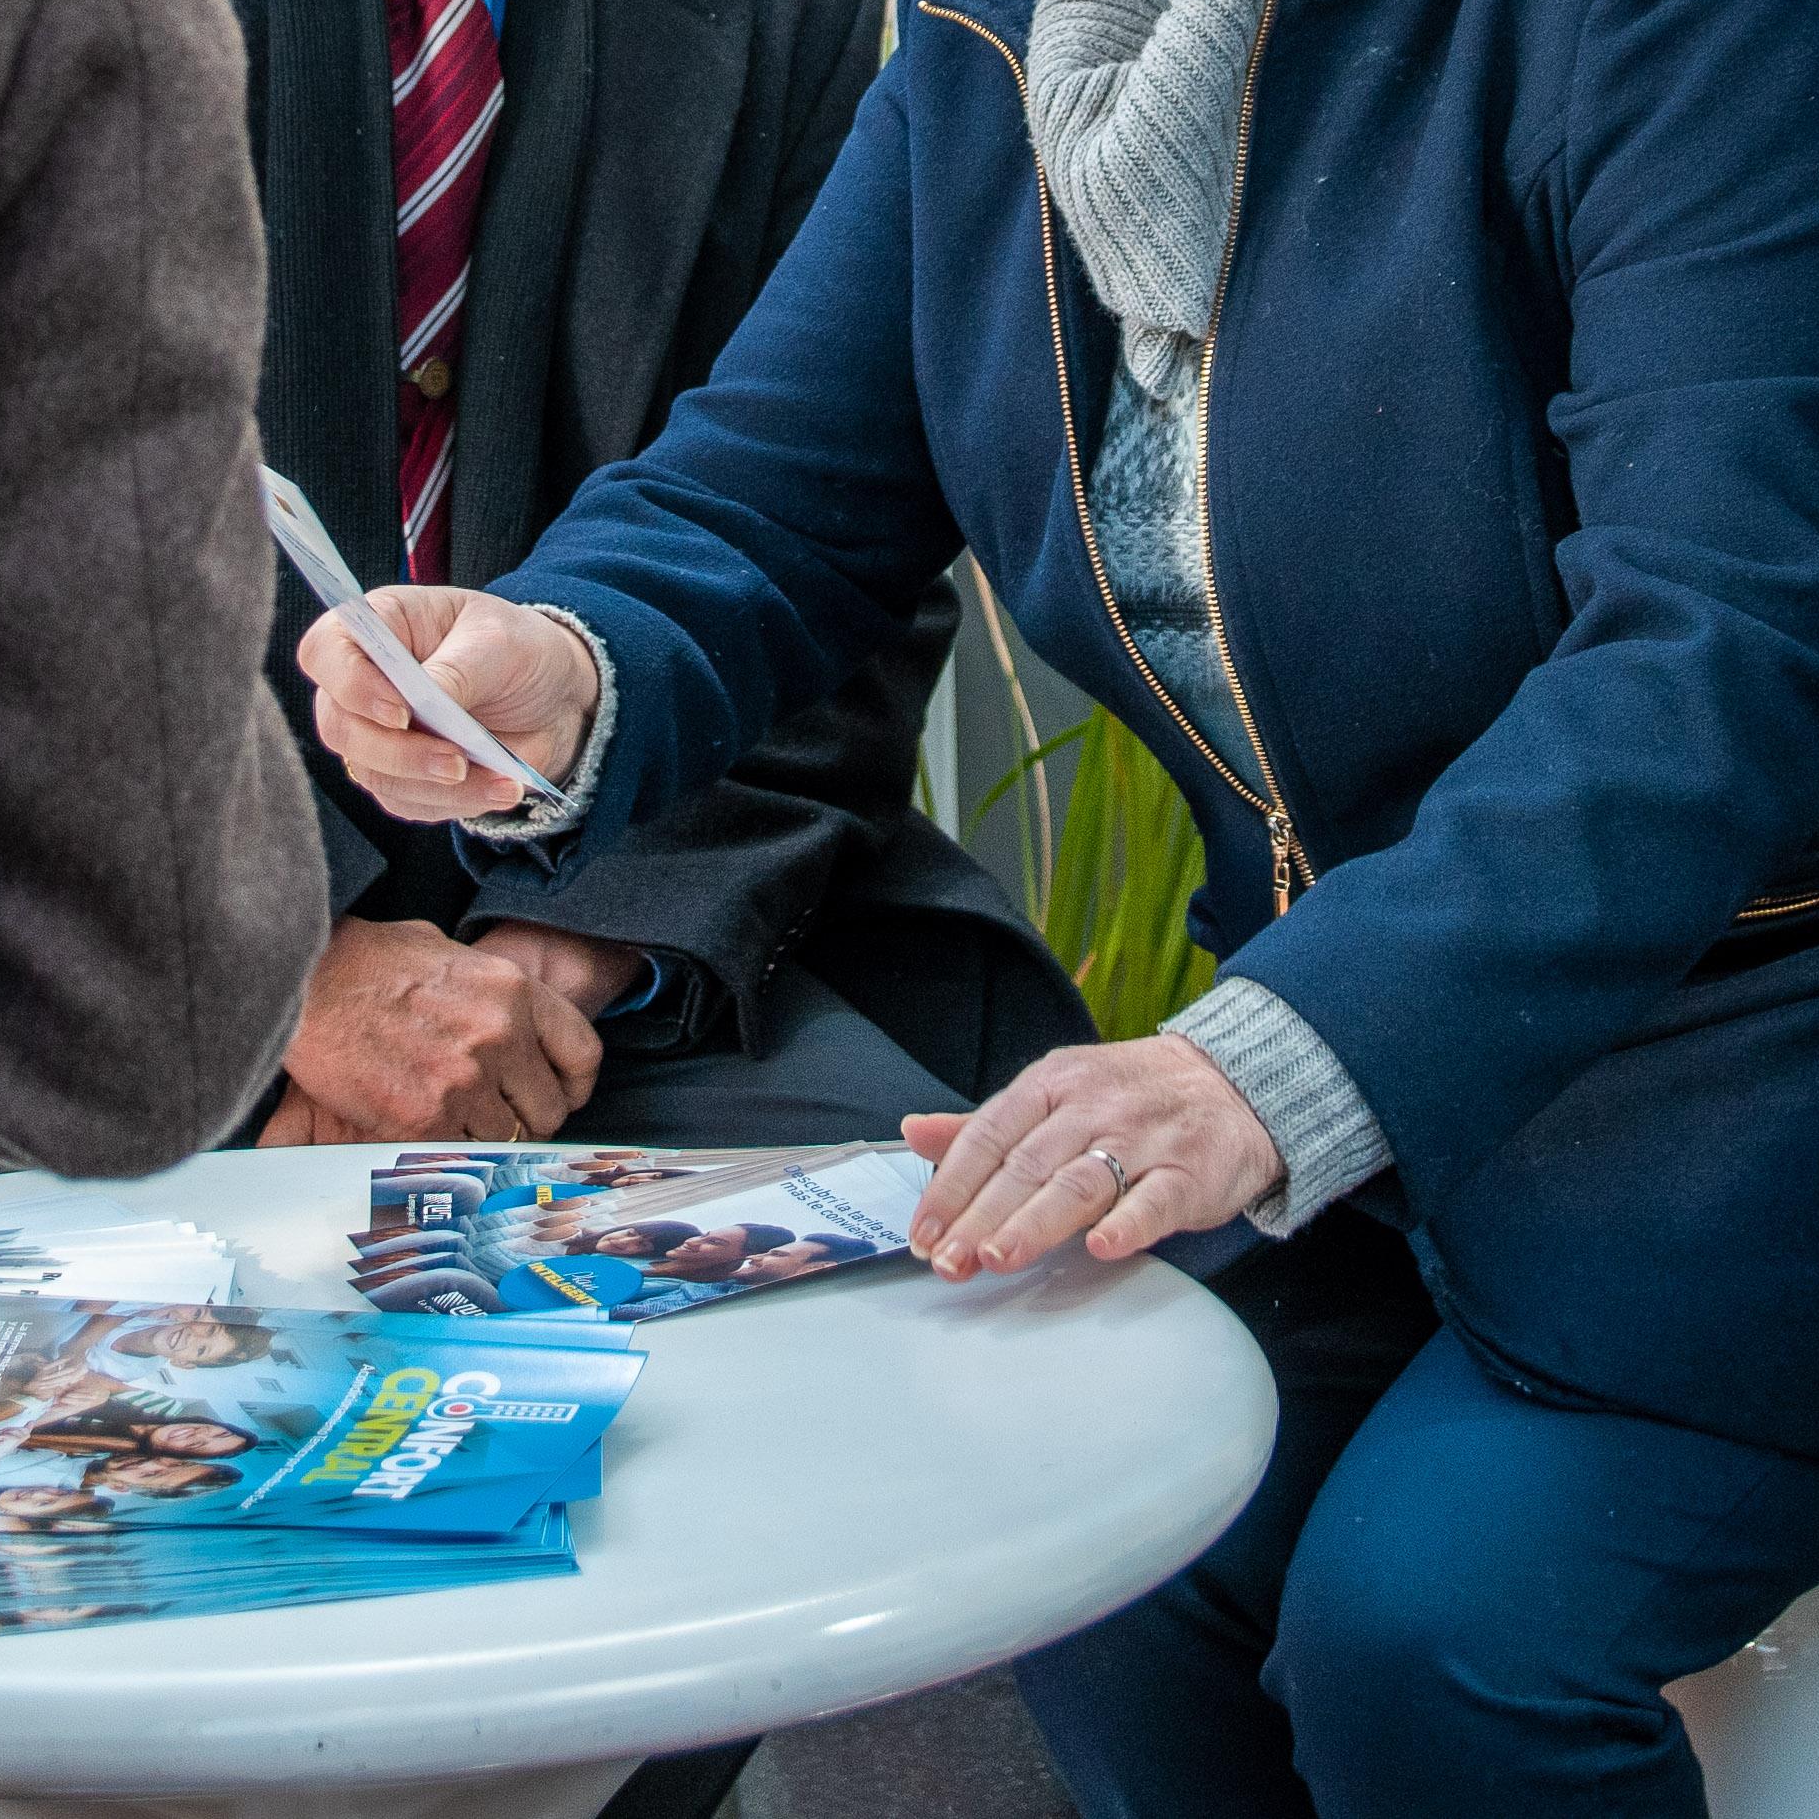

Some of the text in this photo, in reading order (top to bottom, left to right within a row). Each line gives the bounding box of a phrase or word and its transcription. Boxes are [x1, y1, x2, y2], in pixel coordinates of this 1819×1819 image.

[783, 1164, 907, 1245] Descubrí la tarifa que
[806, 1199, 824, 1210] te
[820, 1208, 875, 1241] conviene
[299, 1366, 441, 1485] CENTRAL
